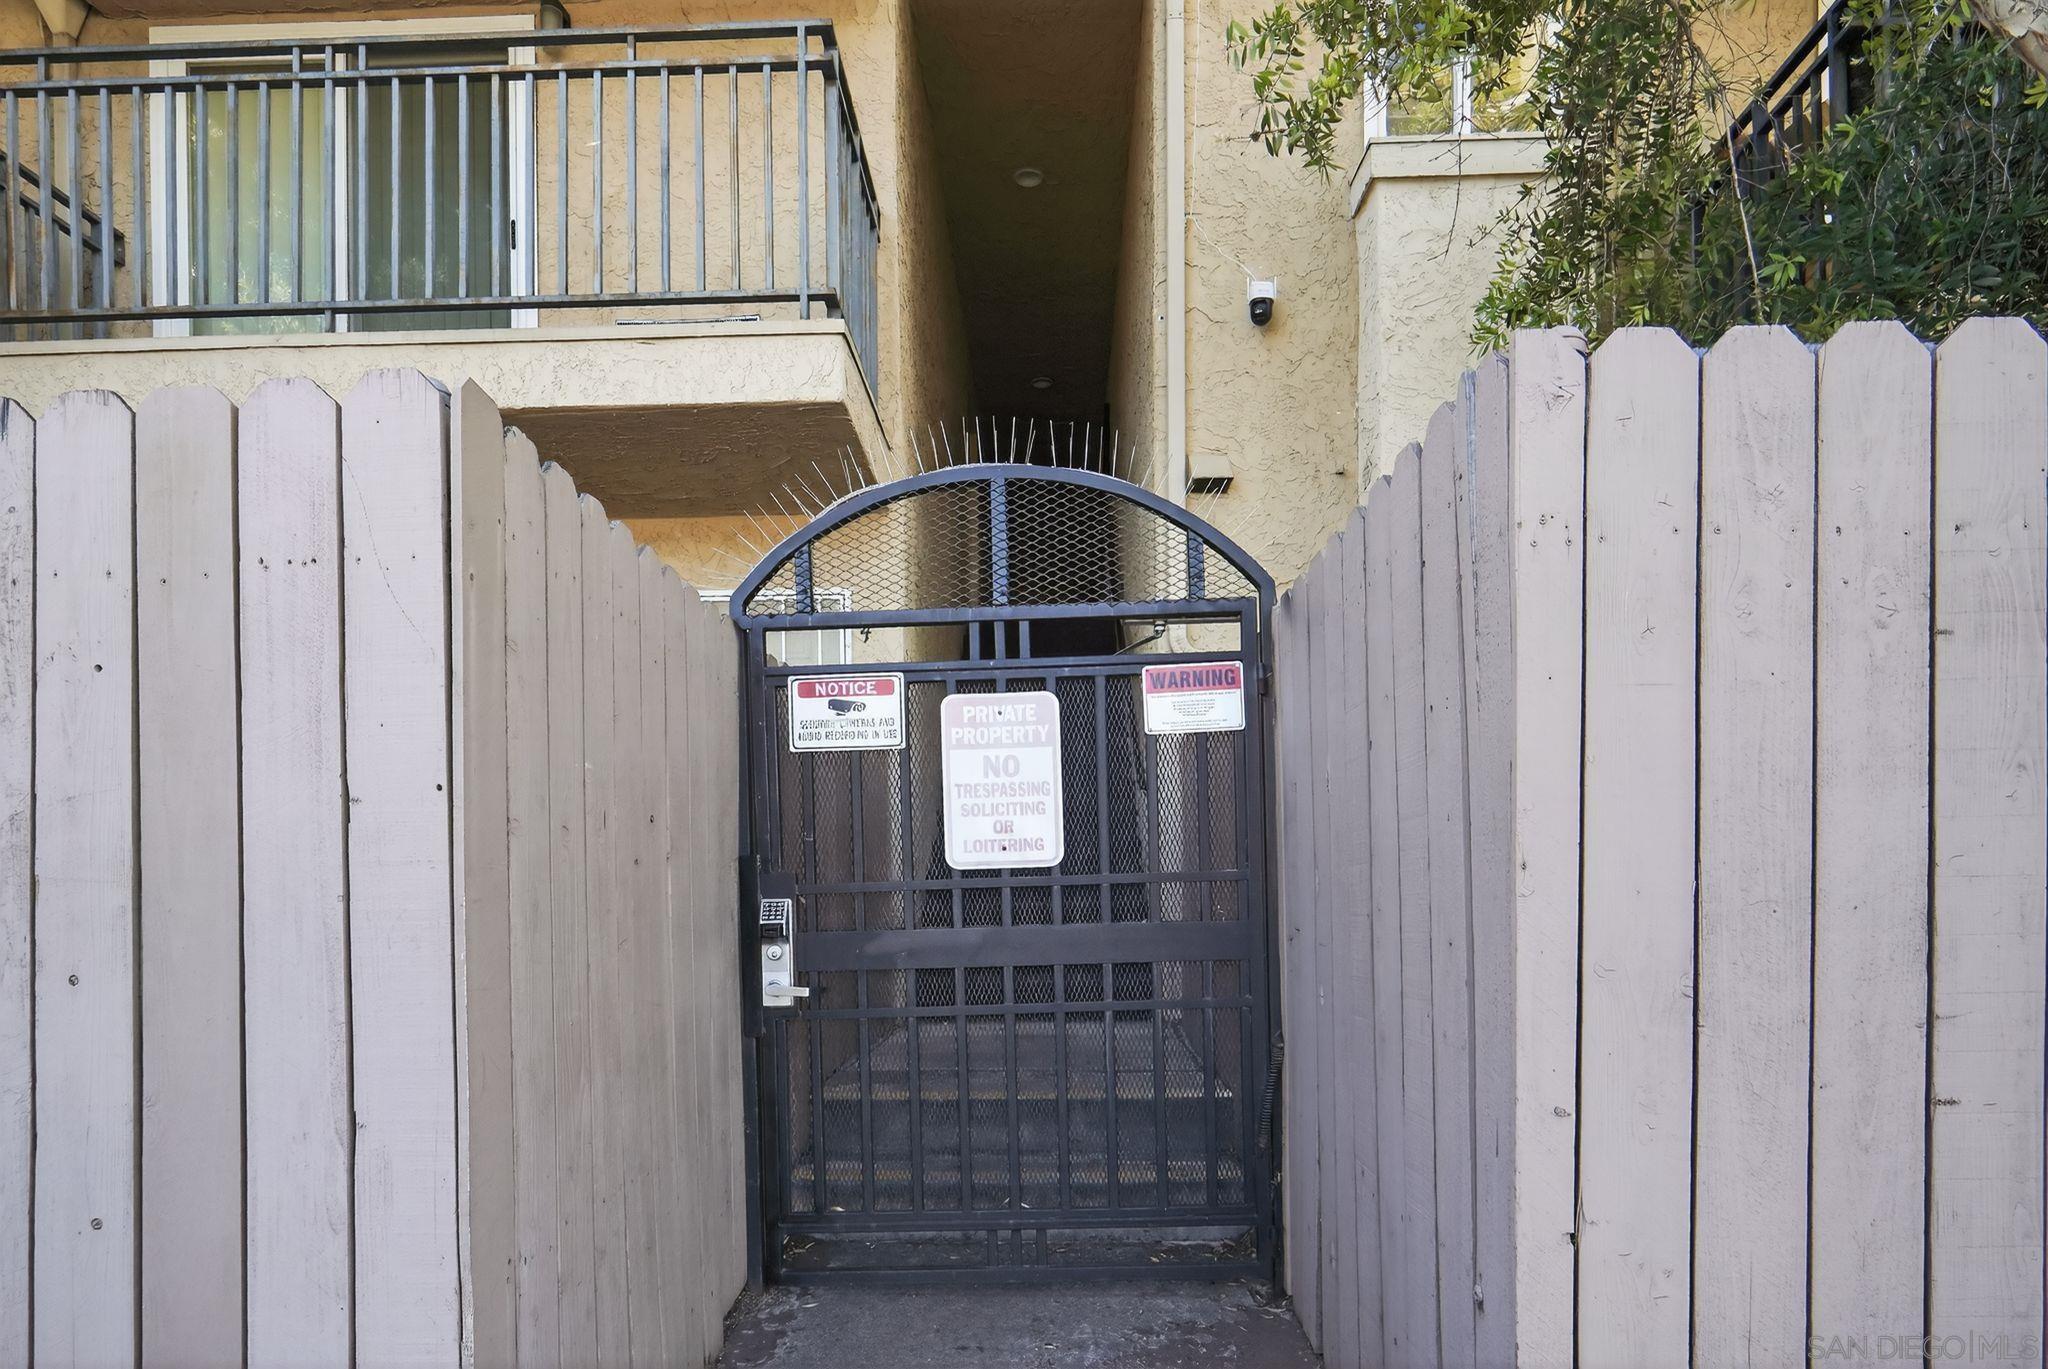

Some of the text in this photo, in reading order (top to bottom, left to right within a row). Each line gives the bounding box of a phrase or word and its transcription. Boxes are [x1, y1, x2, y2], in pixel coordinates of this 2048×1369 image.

[1150, 668, 1236, 690] WARNING
[815, 681, 878, 697] NOTICE
[962, 703, 1037, 723] PRIVATE
[879, 717, 895, 727] AND
[883, 729, 898, 739] USE
[951, 725, 1049, 745] PROPERTY
[983, 754, 1020, 779] NO
[955, 781, 1051, 799] TRESPASSING
[960, 801, 1046, 818] SOLICITING
[993, 819, 1014, 834] OR
[963, 838, 1045, 854] LOITERING
